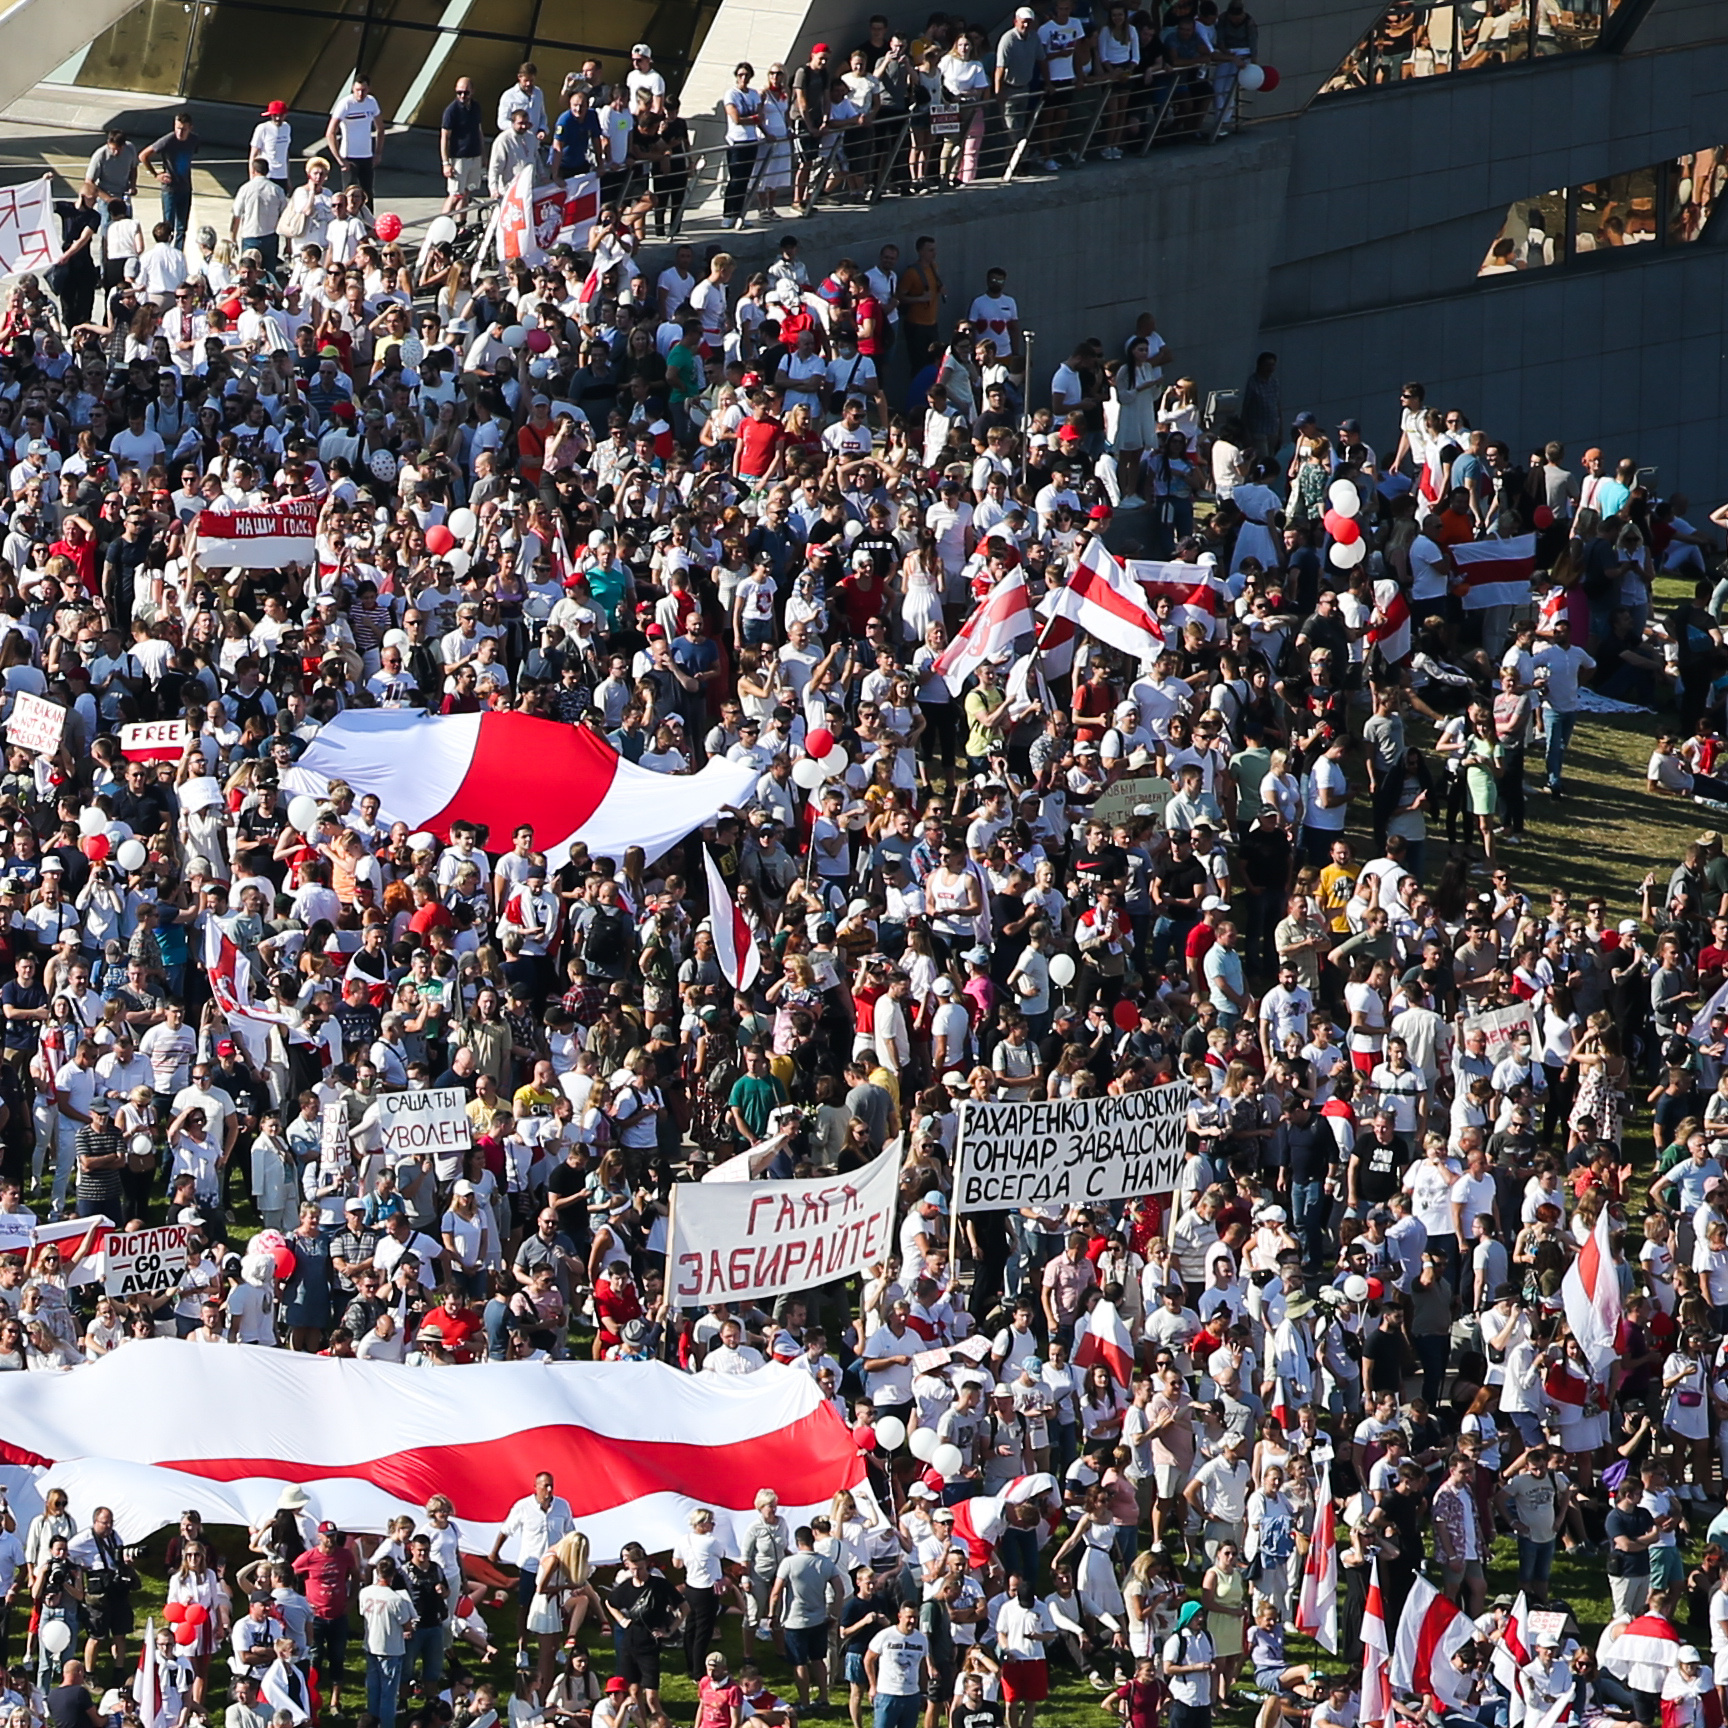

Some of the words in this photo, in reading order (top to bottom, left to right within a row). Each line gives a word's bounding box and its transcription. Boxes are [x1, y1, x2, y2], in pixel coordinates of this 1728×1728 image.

[236, 518, 276, 535] НАШИ
[131, 724, 180, 742] FREE
[434, 1091, 456, 1108] ТЫ
[381, 1120, 469, 1149] УВОЛЕН
[966, 1170, 1070, 1204] ВСЕГДА
[1087, 1166, 1107, 1197] С
[1123, 1156, 1187, 1190] НАМИ
[109, 1227, 188, 1257] DICTATOR
[679, 1208, 891, 1296] ЗАБИРАЙТЕ!
[135, 1255, 160, 1272] GO
[121, 1268, 186, 1293] AWAY
